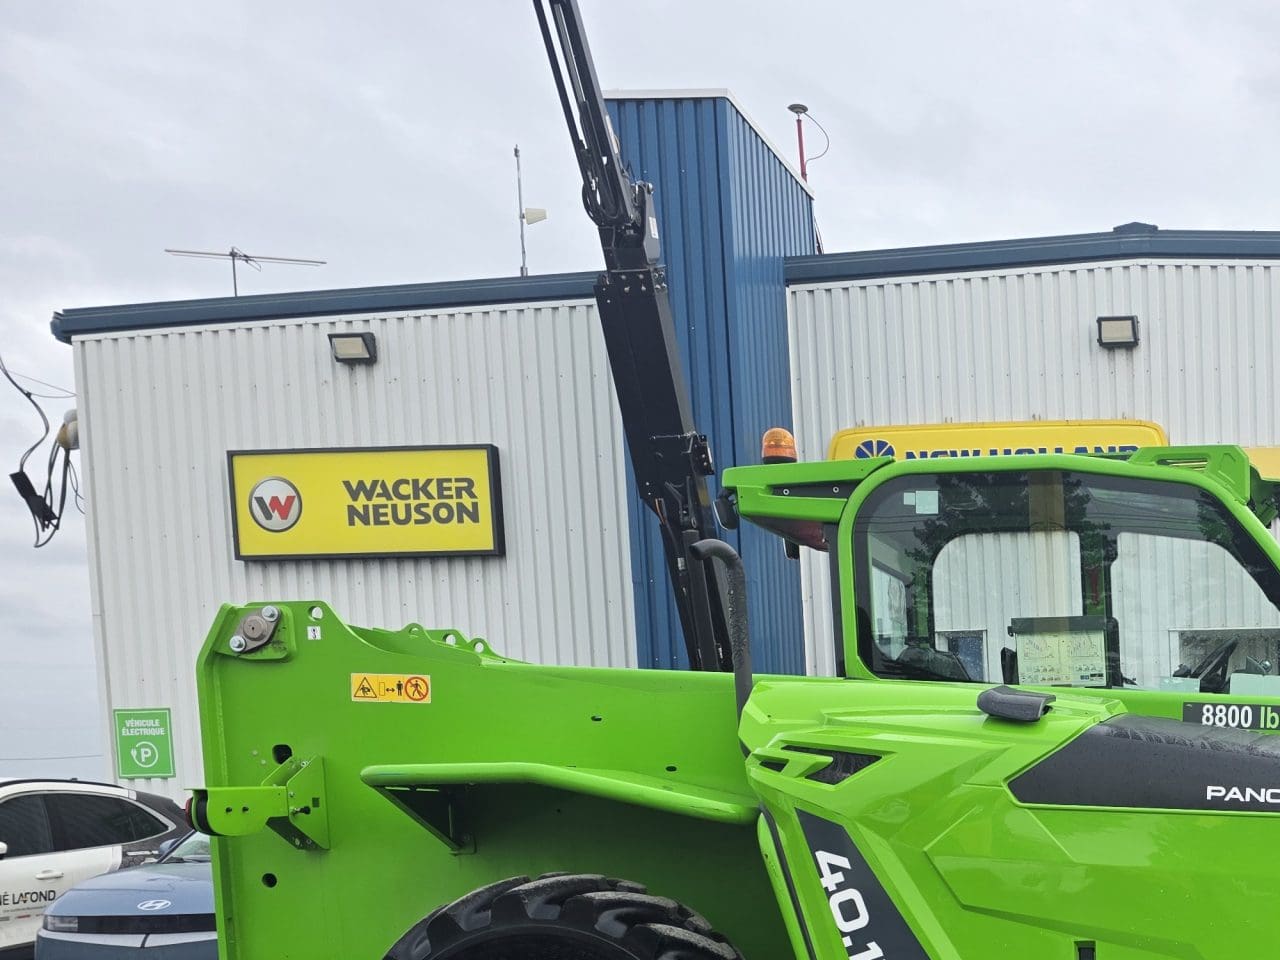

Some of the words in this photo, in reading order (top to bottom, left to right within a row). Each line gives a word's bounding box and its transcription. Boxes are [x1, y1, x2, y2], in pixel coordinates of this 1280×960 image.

[342, 477, 479, 502] WACKER
[347, 502, 480, 526] NEUSON
[125, 717, 161, 728] VÉHICULE
[1202, 704, 1252, 728] 8800
[121, 726, 166, 736] ÉLECTRIQUE
[140, 748, 152, 762] P
